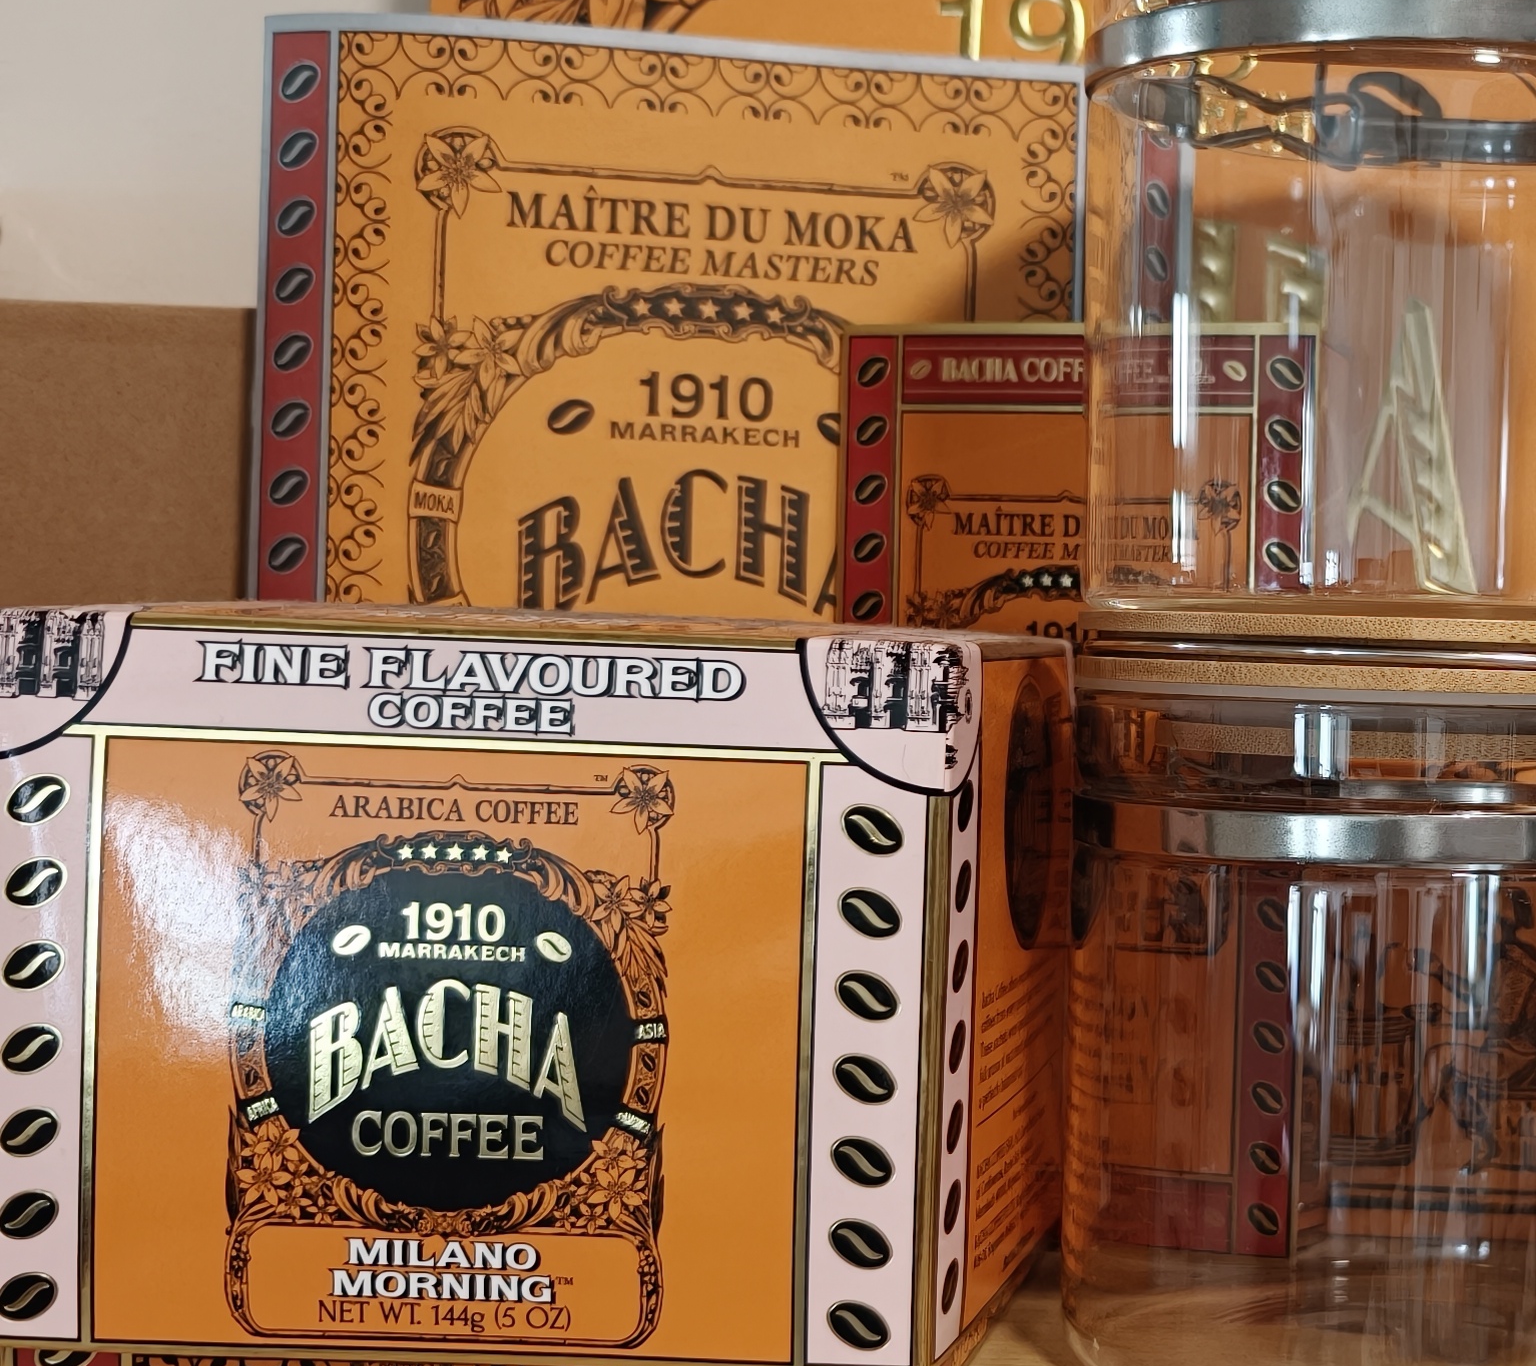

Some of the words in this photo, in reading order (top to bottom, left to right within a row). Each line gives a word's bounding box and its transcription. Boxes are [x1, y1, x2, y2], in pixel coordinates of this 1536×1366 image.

[506, 184, 692, 240] MAÎTRE
[704, 204, 771, 244] DU
[783, 210, 918, 254] MOKA
[545, 239, 692, 276] COFFEE
[702, 251, 881, 287] MASTERS
[639, 371, 774, 423] 1910
[609, 420, 800, 449] MARRAKECH
[413, 491, 455, 516] MOKA
[953, 506, 1056, 538] MAÎTRE
[973, 540, 1056, 561] COFFEE
[195, 639, 351, 690] FINE
[361, 645, 748, 702] FLAVOURED
[366, 691, 576, 737] COFFEE
[328, 794, 465, 822] ARABICA
[475, 799, 579, 826] COFFEE
[402, 901, 506, 943] 1910
[378, 941, 527, 962] MARRAKECH
[637, 1023, 667, 1040] ASIA
[308, 978, 588, 1124] BACHA
[351, 1110, 544, 1161] COFFEE
[346, 1237, 541, 1272] MILANO
[329, 1268, 557, 1304] MORNING
[318, 1299, 370, 1324] NET
[379, 1302, 421, 1325] WT.
[431, 1305, 485, 1333] 144g
[494, 1305, 516, 1330] (5
[525, 1306, 571, 1332] OZ)
